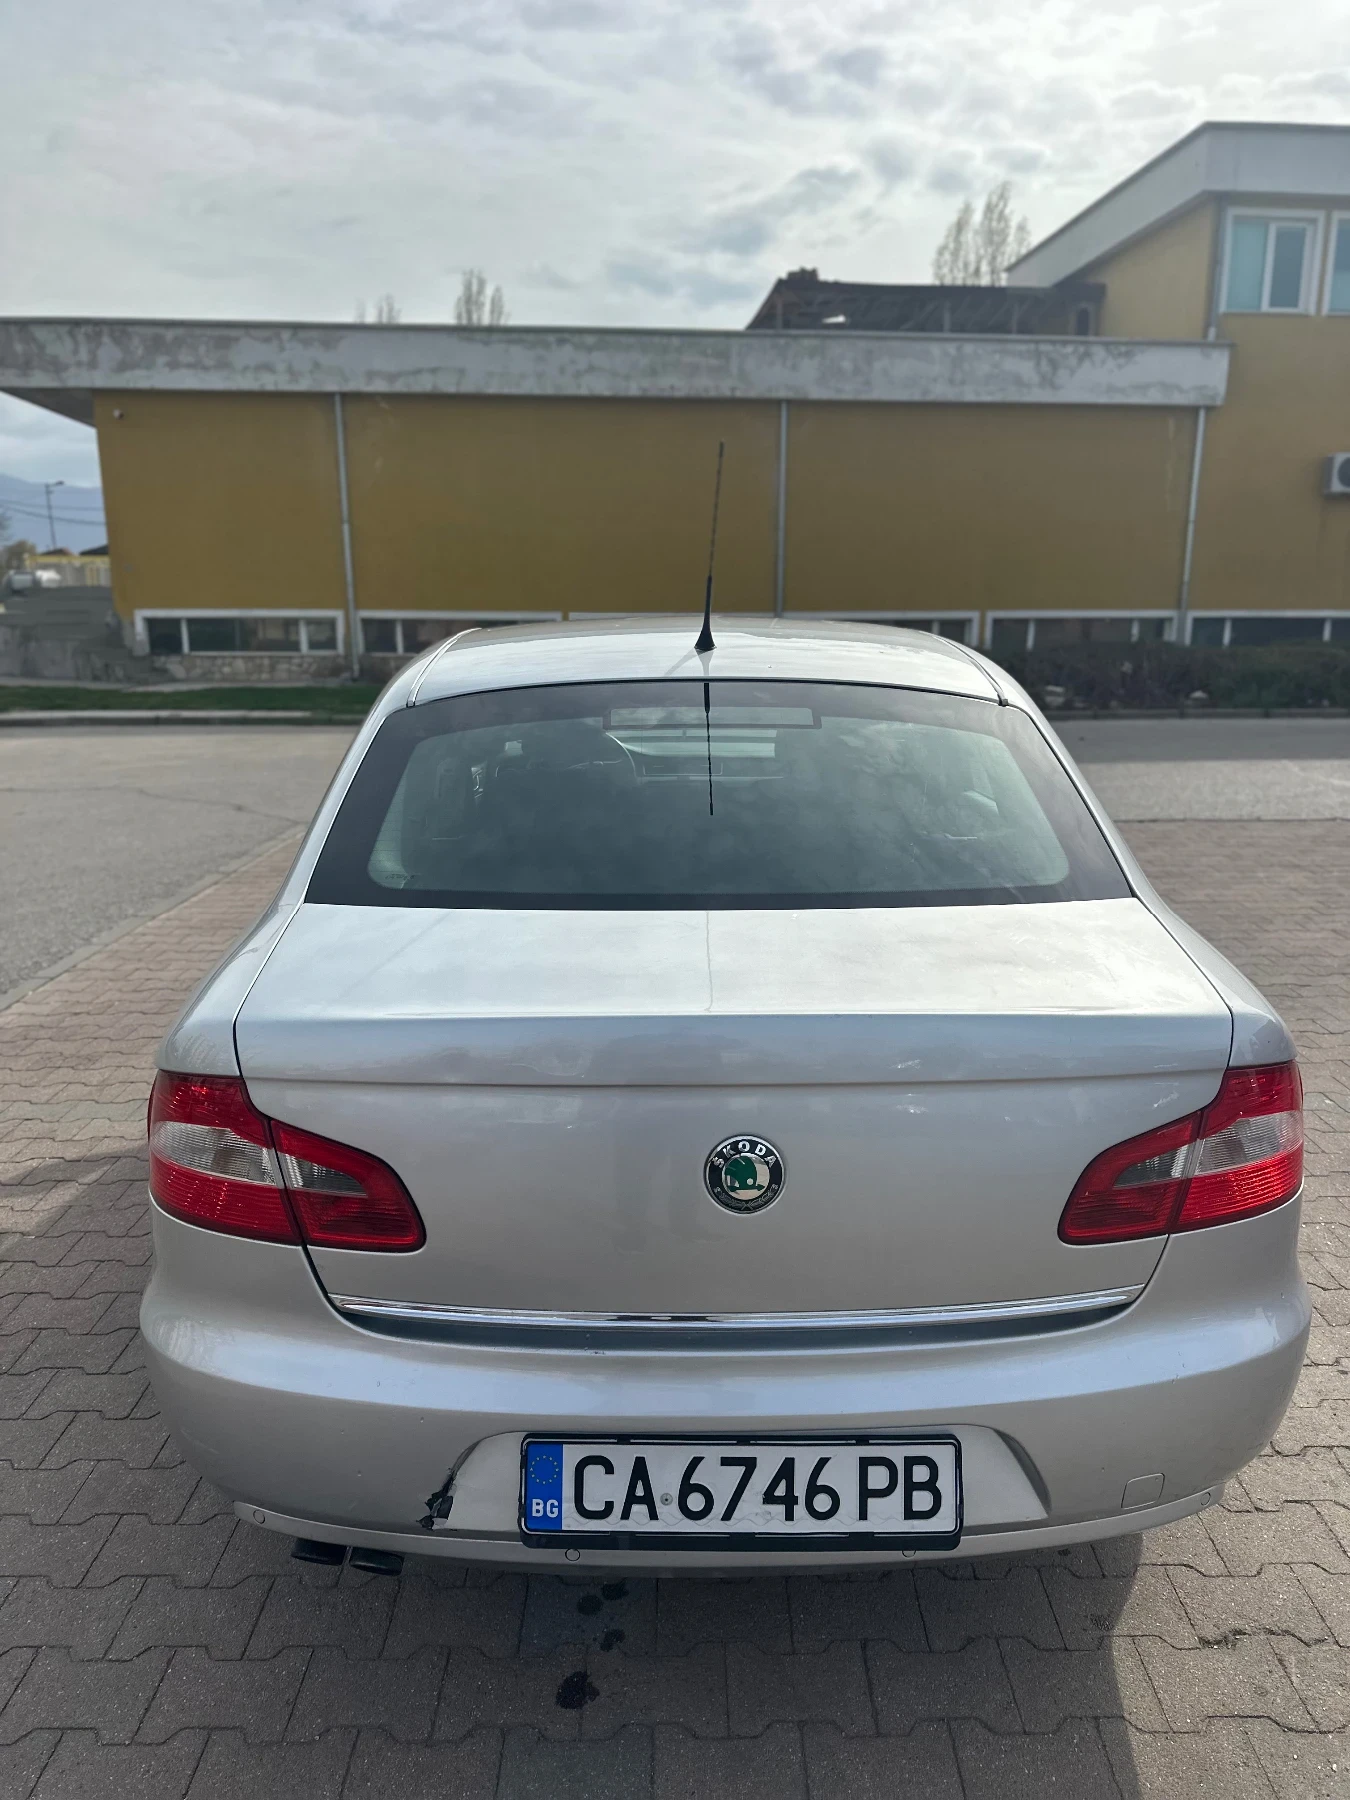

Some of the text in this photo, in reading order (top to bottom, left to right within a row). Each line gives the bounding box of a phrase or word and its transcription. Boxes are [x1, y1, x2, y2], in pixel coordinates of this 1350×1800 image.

[531, 1499, 559, 1518] BG
[574, 1455, 942, 1521] CA 6746 PB
